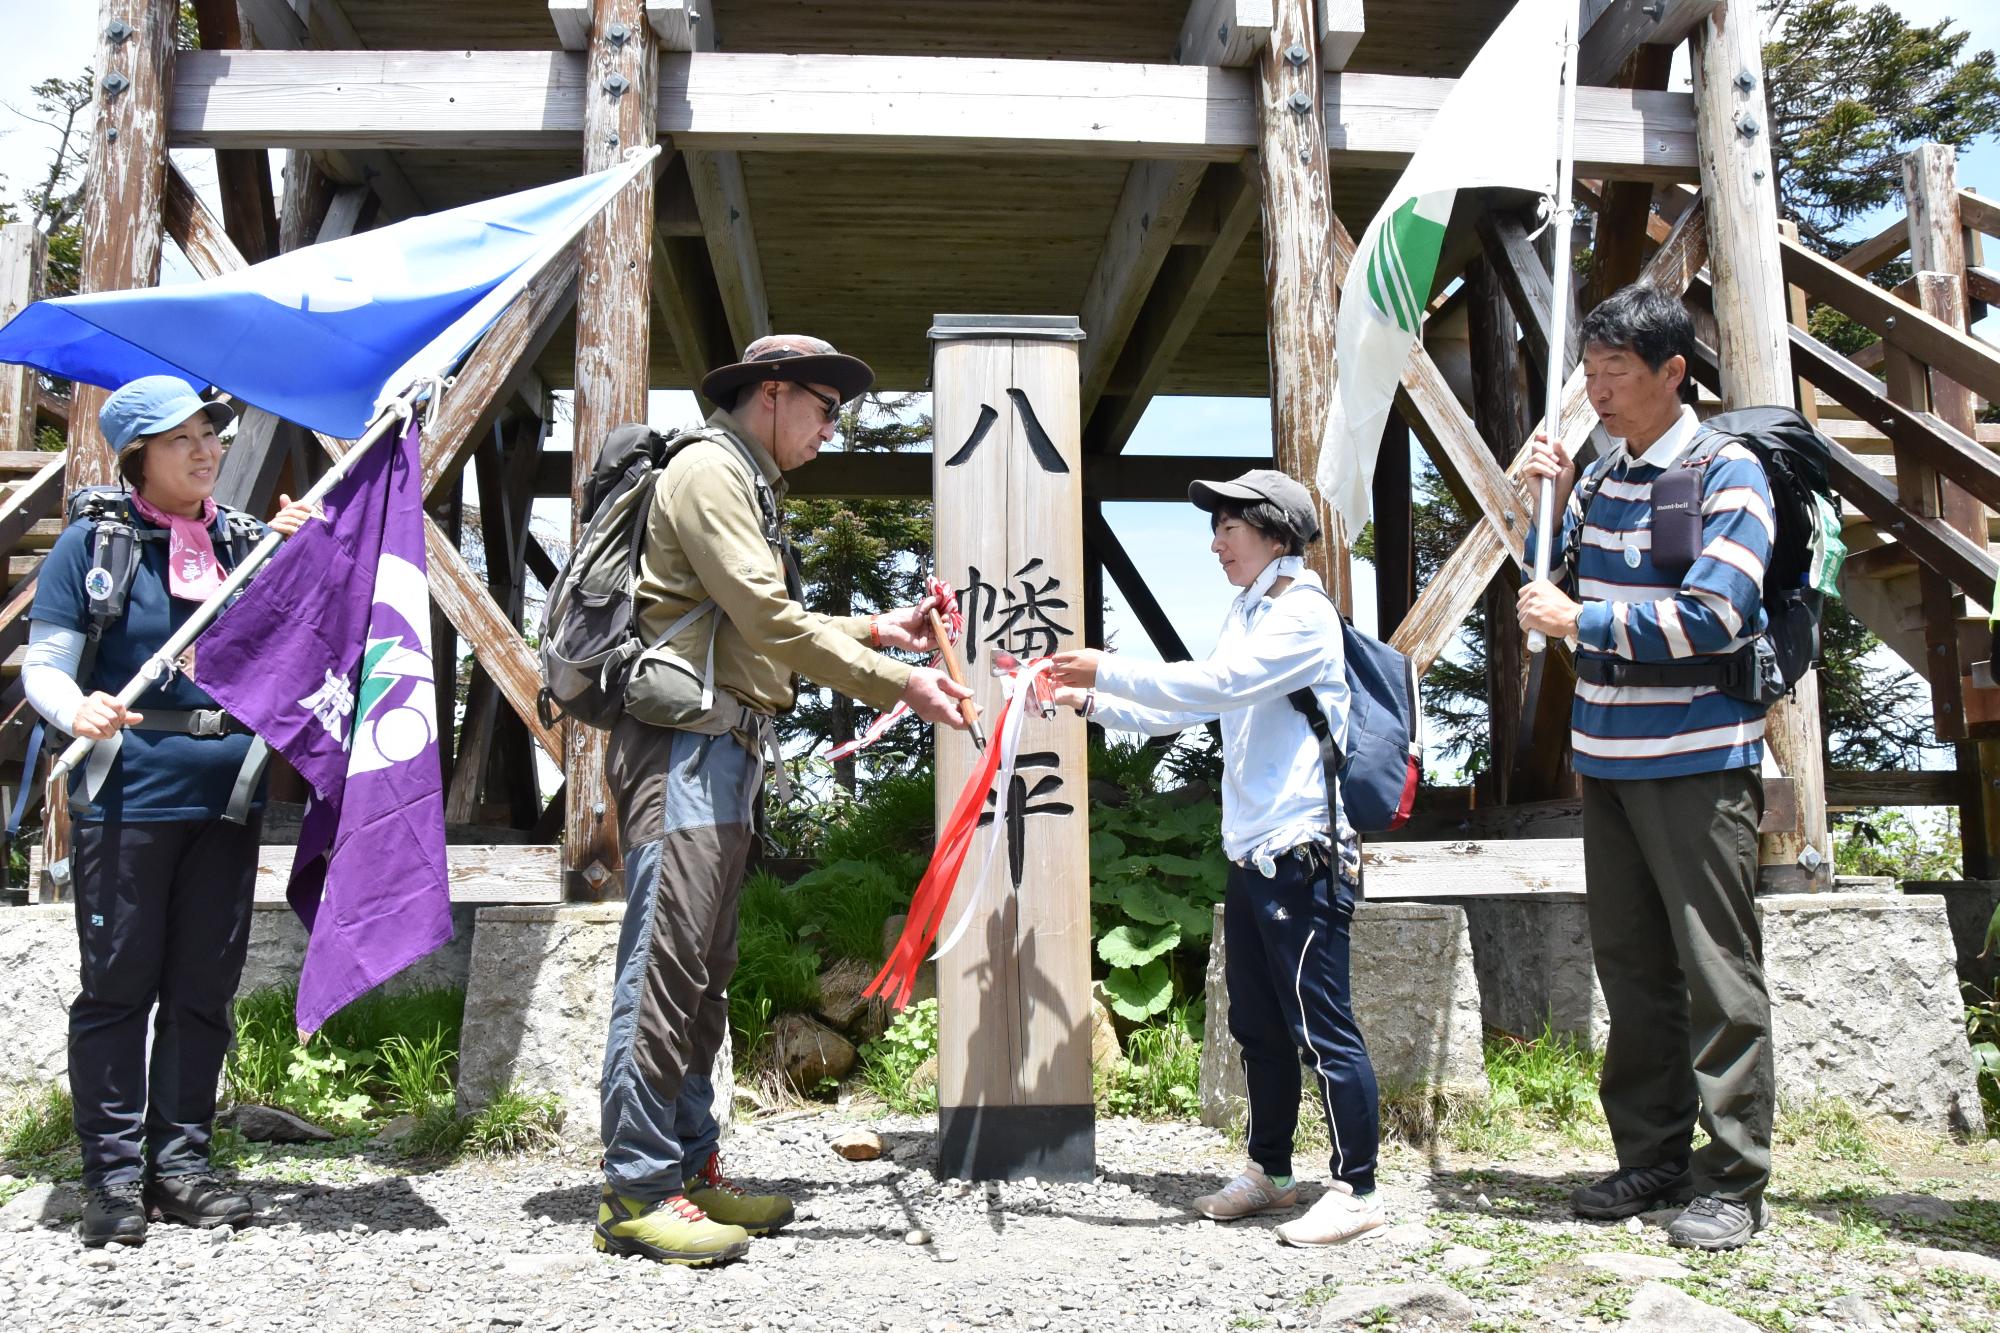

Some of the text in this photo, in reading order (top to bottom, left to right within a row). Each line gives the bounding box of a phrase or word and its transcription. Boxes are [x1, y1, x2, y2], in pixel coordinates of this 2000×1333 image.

[297, 668, 355, 753] 鹿
[944, 387, 1074, 889] 八幡平
